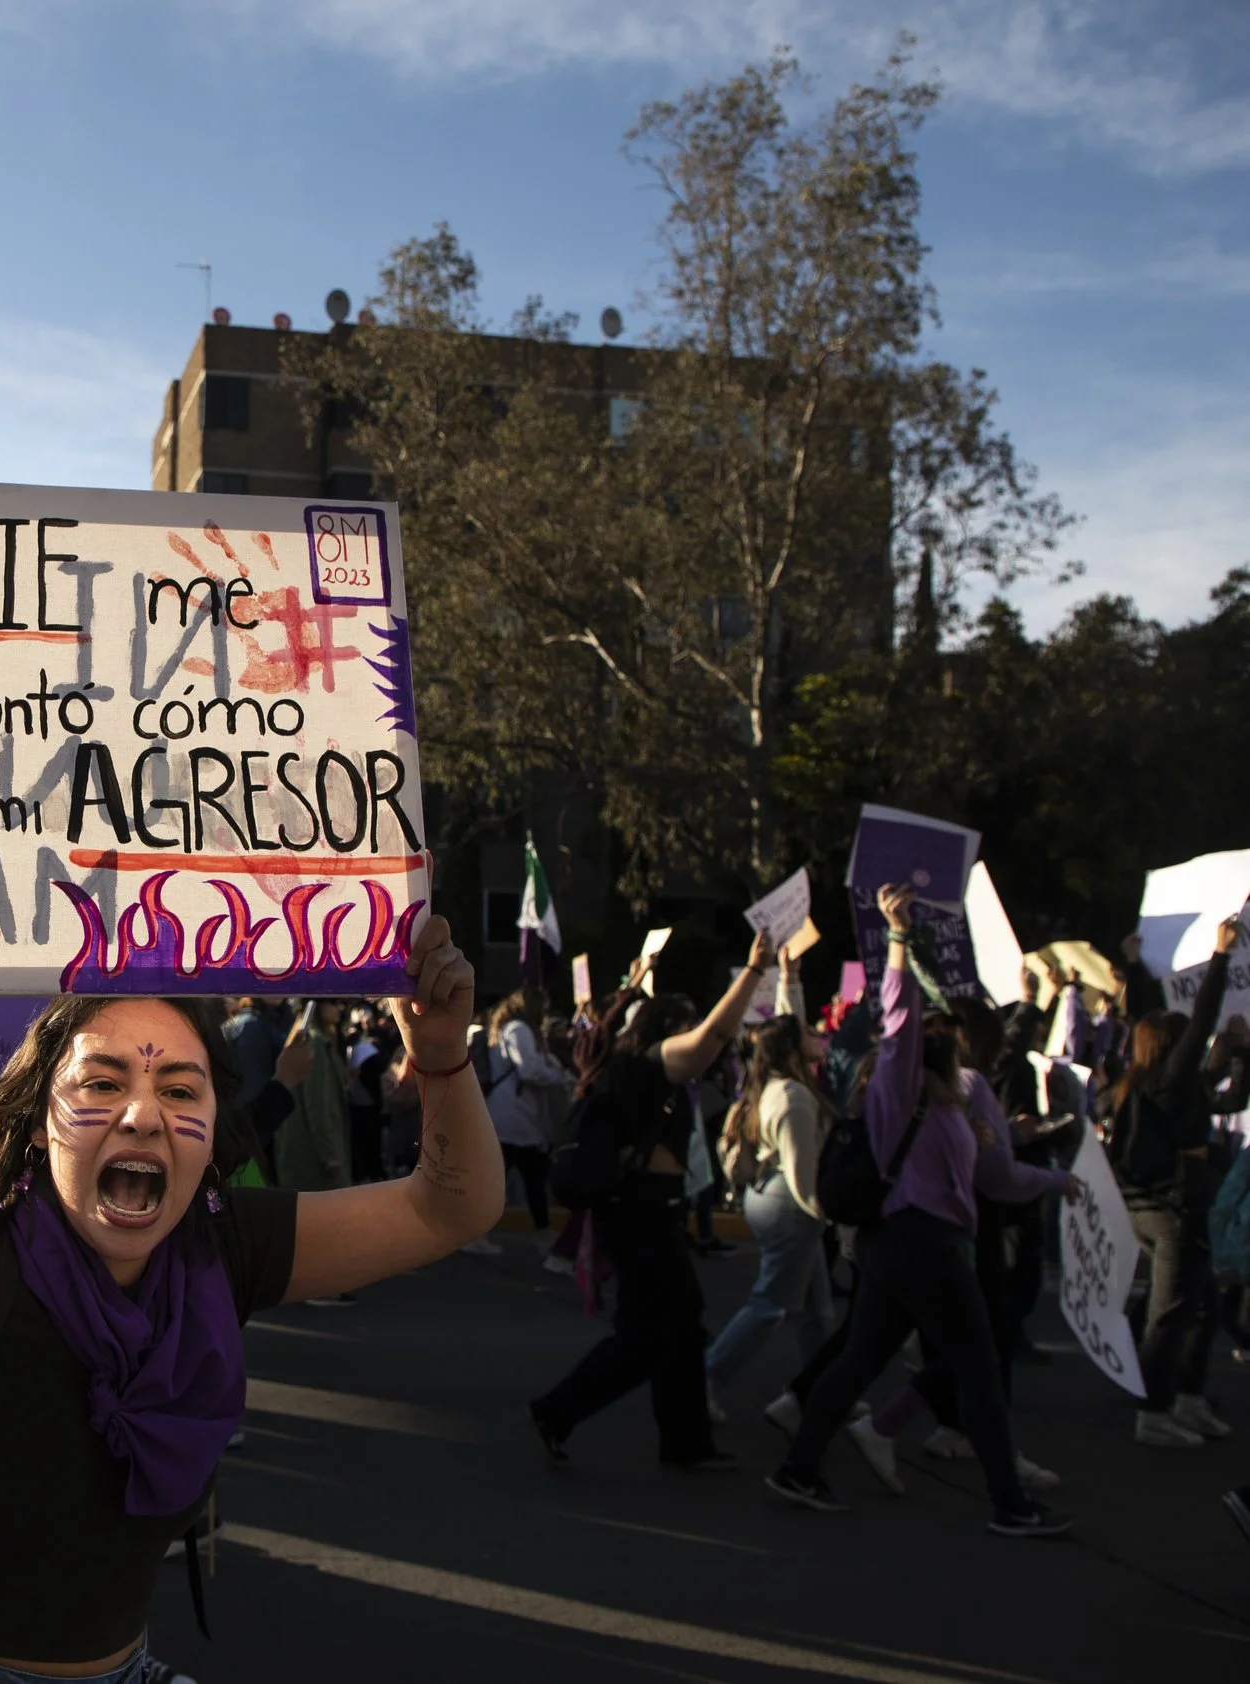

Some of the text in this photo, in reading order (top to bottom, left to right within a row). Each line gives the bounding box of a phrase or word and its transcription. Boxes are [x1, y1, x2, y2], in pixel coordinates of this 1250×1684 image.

[316, 514, 369, 565] 8M
[147, 576, 259, 629] me
[322, 567, 371, 587] 2023
[133, 684, 305, 740] cómo
[66, 743, 423, 854] AGRESOR
